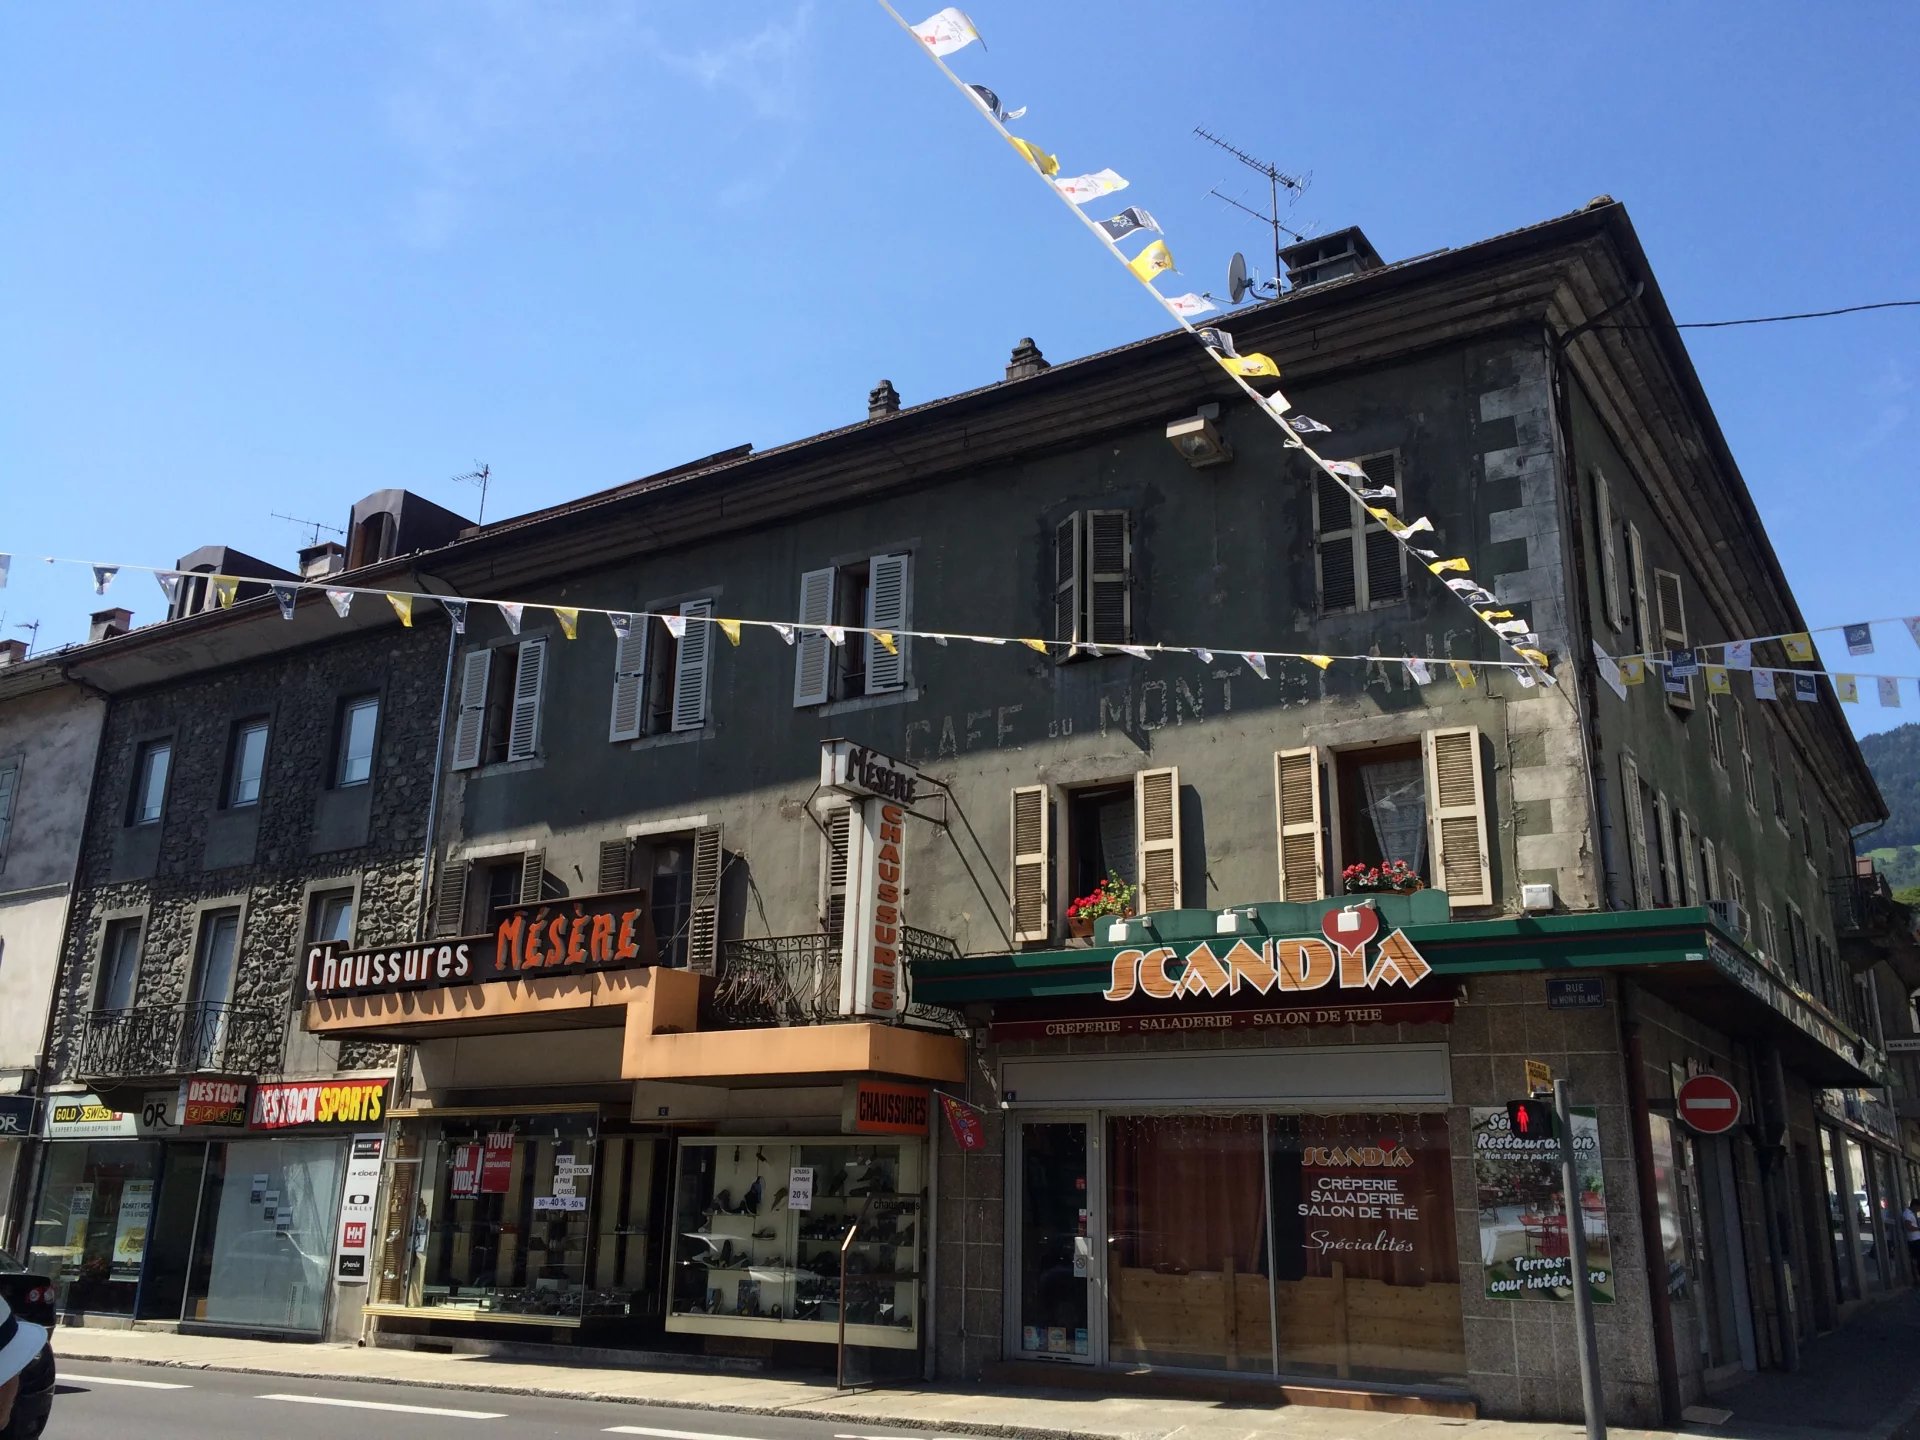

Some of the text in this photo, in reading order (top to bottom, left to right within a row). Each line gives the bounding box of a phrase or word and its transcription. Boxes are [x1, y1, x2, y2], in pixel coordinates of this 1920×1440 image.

[1101, 666, 1242, 738] MONT
[871, 804, 903, 1011] CHAUSSURES
[306, 942, 470, 992] Chaussures
[1103, 927, 1433, 1001] SCANDIA
[1565, 983, 1585, 993] RUE
[1045, 1008, 1382, 1036] CREPERIE SALADERIE SALON DE THE
[189, 1081, 248, 1104] DESTOCK
[56, 1106, 110, 1121] GOLD SWISS
[143, 1103, 179, 1128] OR
[859, 1091, 926, 1126] CHAUSSURES
[488, 1133, 515, 1149] TOUT
[1477, 1132, 1595, 1151] Restauraon
[456, 1147, 470, 1168] ON
[1301, 1145, 1415, 1168] SCANDIA
[1484, 1151, 1500, 1161] Non
[1502, 1151, 1521, 1162] stop
[1530, 1150, 1560, 1162] partir
[452, 1170, 475, 1191] VIDE
[1317, 1175, 1399, 1191] CRÊPERIE
[792, 1190, 809, 1199] 20 %
[1310, 1189, 1405, 1206] SALADERIE
[1297, 1203, 1420, 1221] SALON DE THÉ
[1301, 1228, 1414, 1256] Spécialités
[1491, 1271, 1606, 1293] cour intérre
